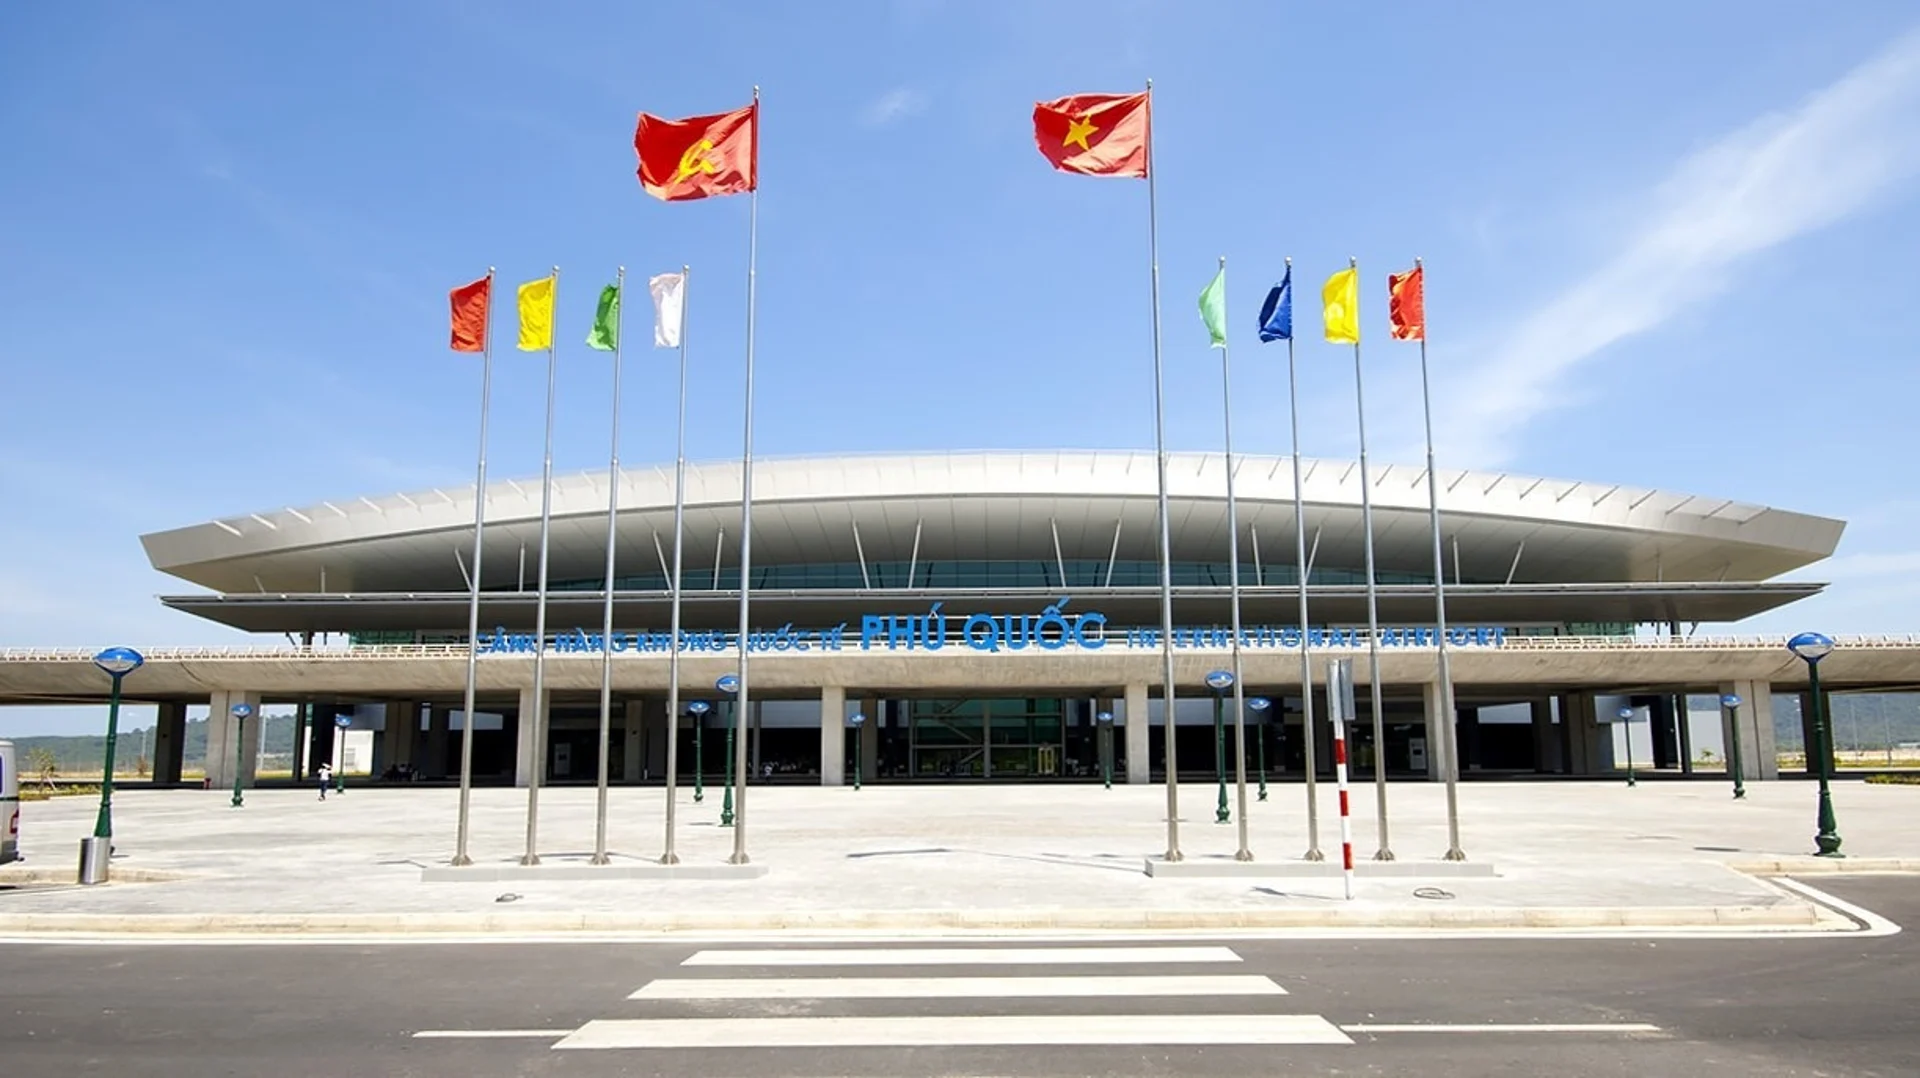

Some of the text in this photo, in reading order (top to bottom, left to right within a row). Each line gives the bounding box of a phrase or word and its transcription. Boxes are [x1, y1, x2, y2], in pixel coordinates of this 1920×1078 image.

[555, 627, 629, 653] HÀNG
[820, 623, 847, 651] TẾ
[862, 602, 945, 650] PHÚ
[963, 596, 1107, 652] QUỐC
[1127, 628, 1361, 648] INERNATIONAL
